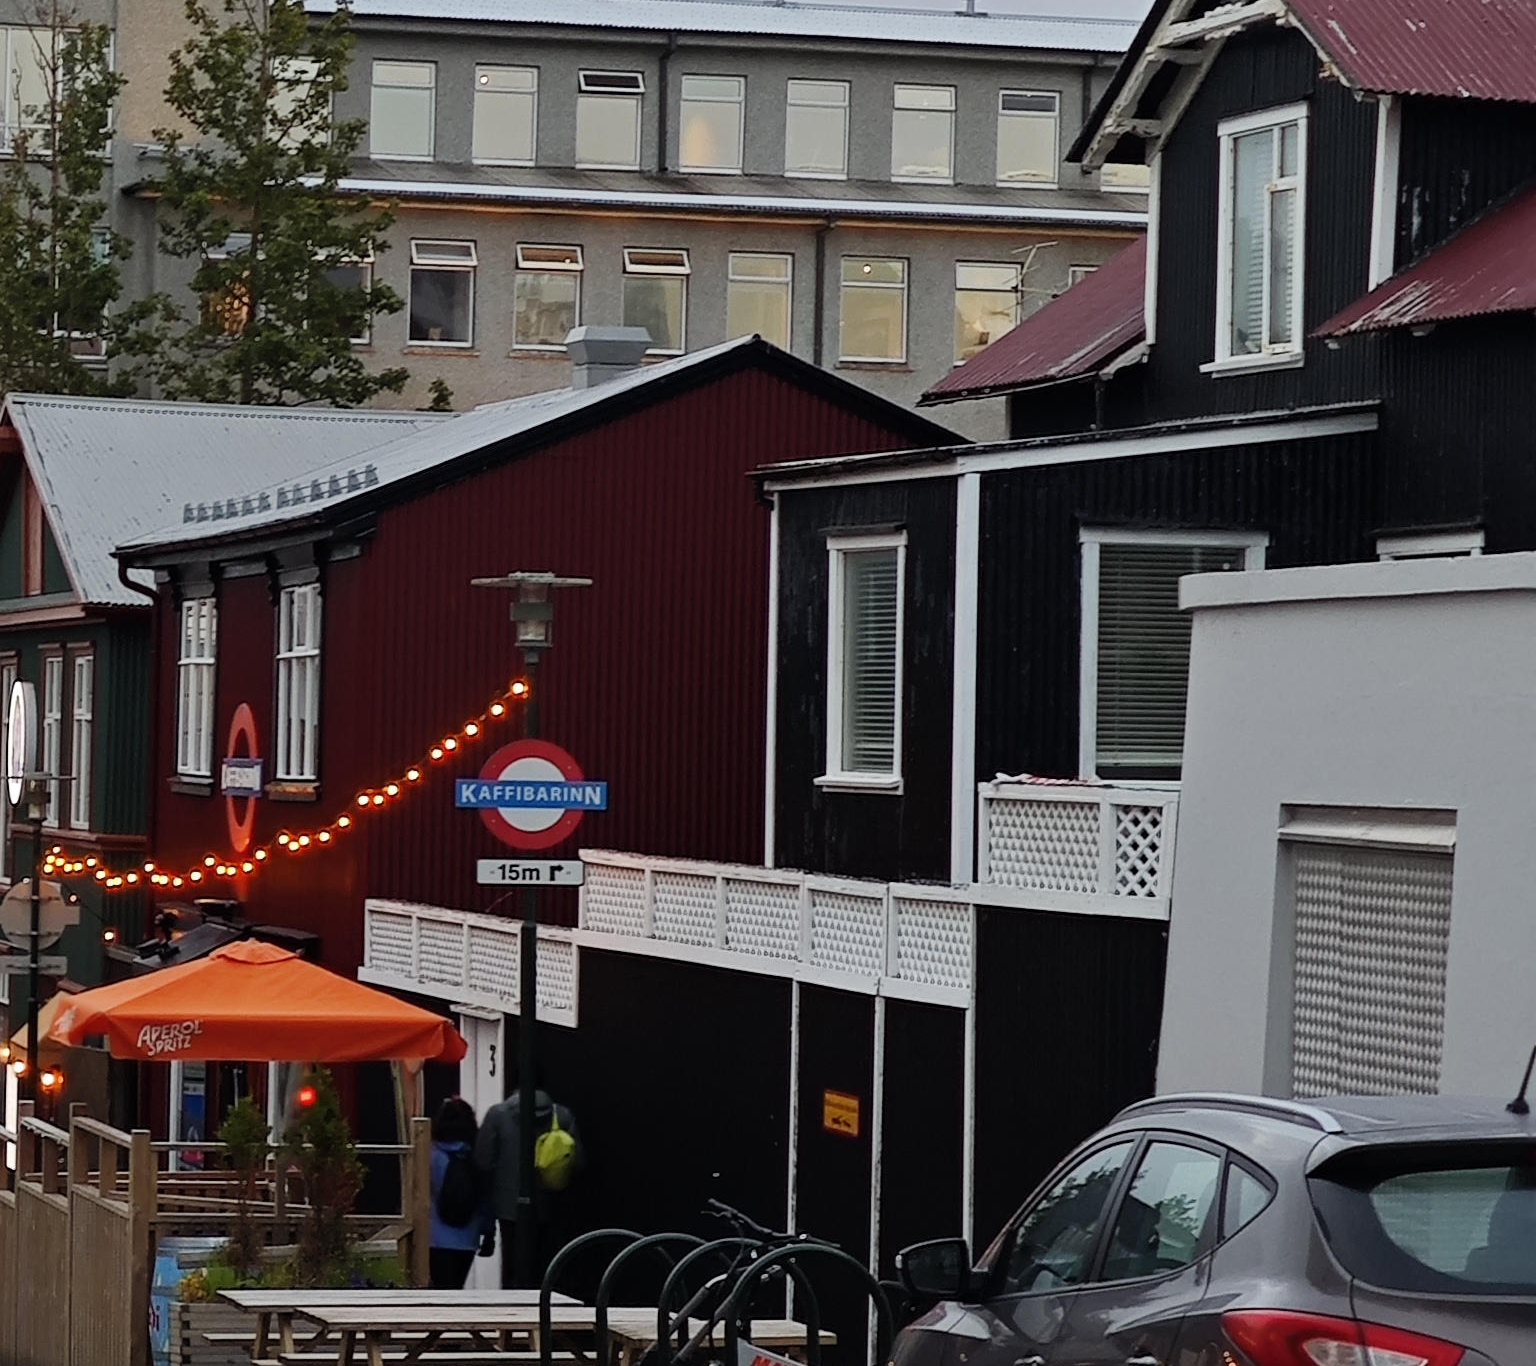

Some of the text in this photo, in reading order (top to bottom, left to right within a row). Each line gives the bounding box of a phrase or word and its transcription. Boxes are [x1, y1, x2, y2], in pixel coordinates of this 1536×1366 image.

[461, 784, 602, 806] KAFFIBARINN
[498, 864, 541, 881] 15m
[136, 1019, 203, 1048] APEROL
[148, 1035, 191, 1057] SPRITZ
